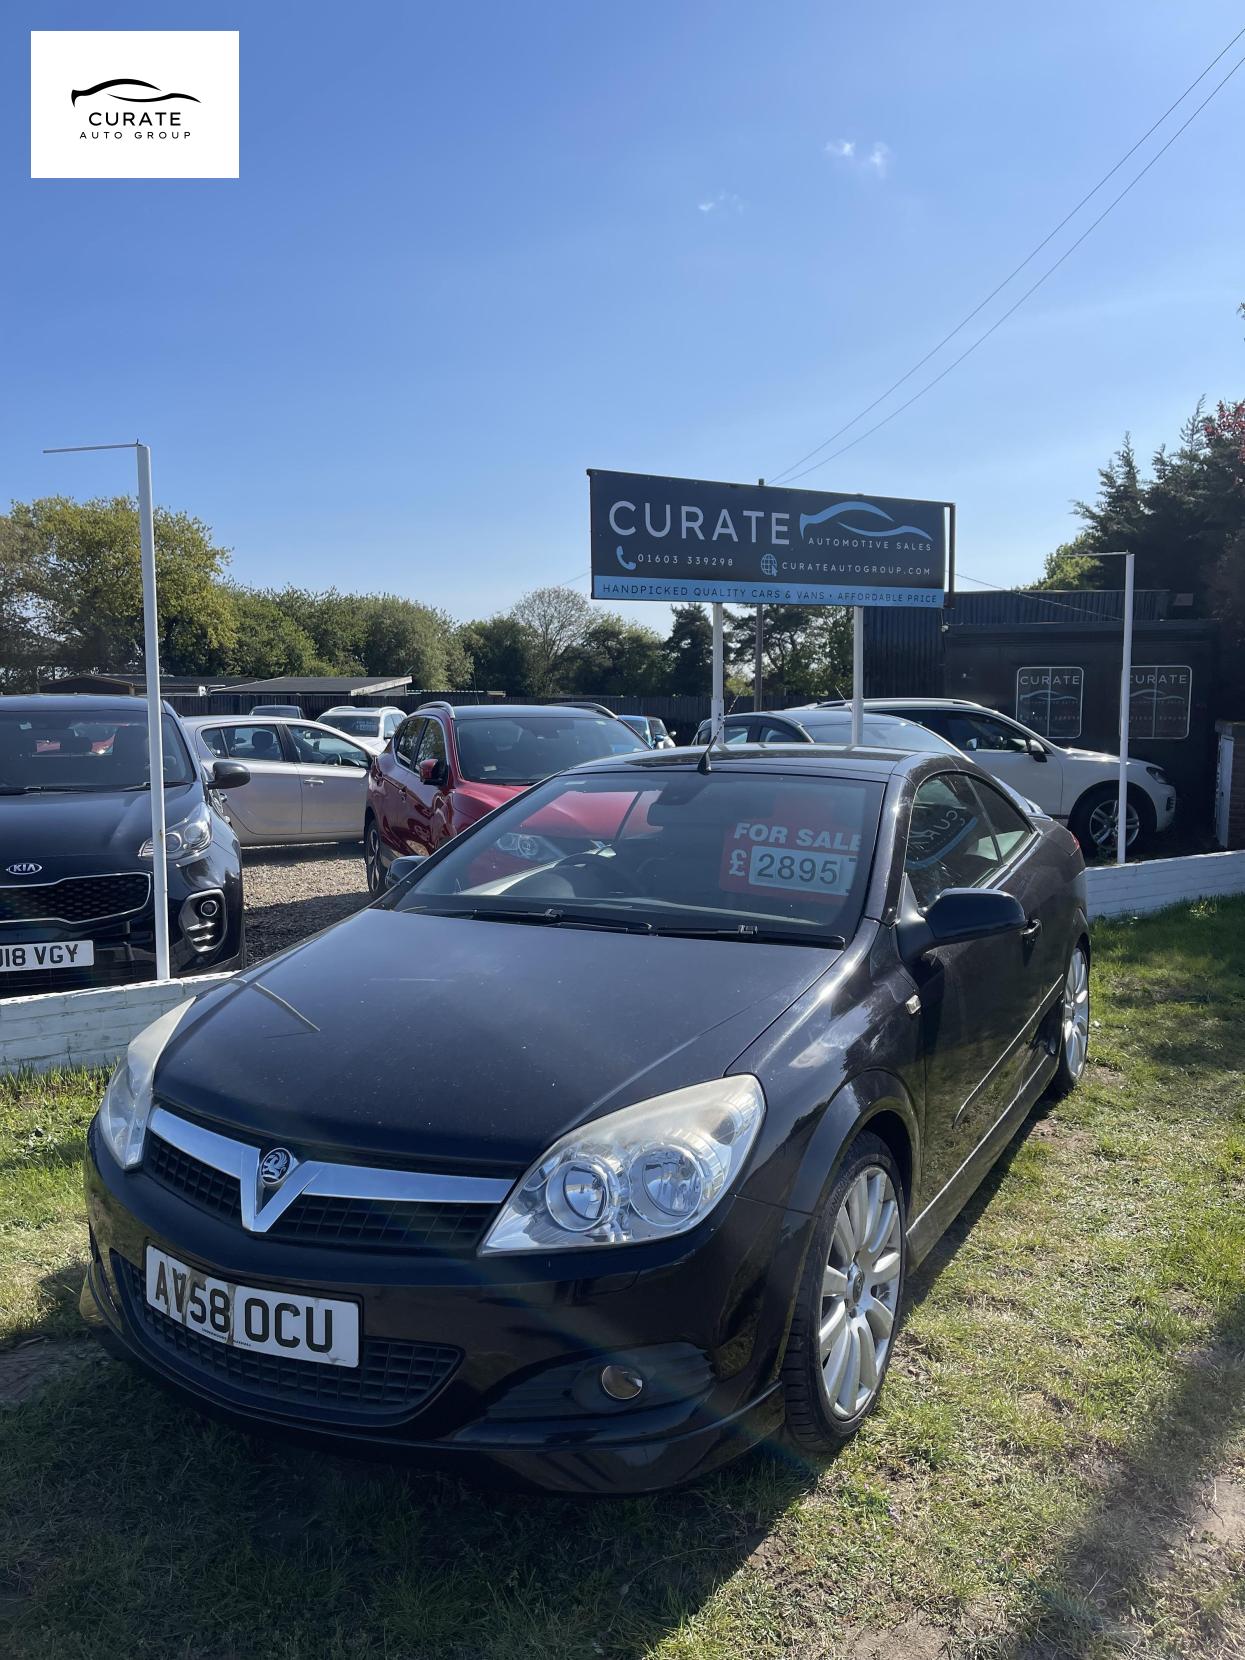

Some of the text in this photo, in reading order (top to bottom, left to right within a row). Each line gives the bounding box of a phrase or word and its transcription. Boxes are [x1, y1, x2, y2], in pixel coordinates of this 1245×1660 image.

[609, 501, 790, 545] CURATE
[808, 537, 931, 551] AUTOMOTIVE SALES
[637, 553, 733, 566] 01603 339298
[782, 561, 930, 575] CURATEAUTOGROUP.COM
[603, 584, 937, 603] HANDPICKED QUALITY CARS & VANS AFFORDABLE PRICE
[1019, 675, 1080, 685] CURATE
[734, 822, 789, 844] FOR
[13, 863, 36, 873] KIA
[728, 849, 838, 885] £ 2895
[0, 943, 79, 967] 18 VGY
[155, 1261, 333, 1354] AV58 OCU
